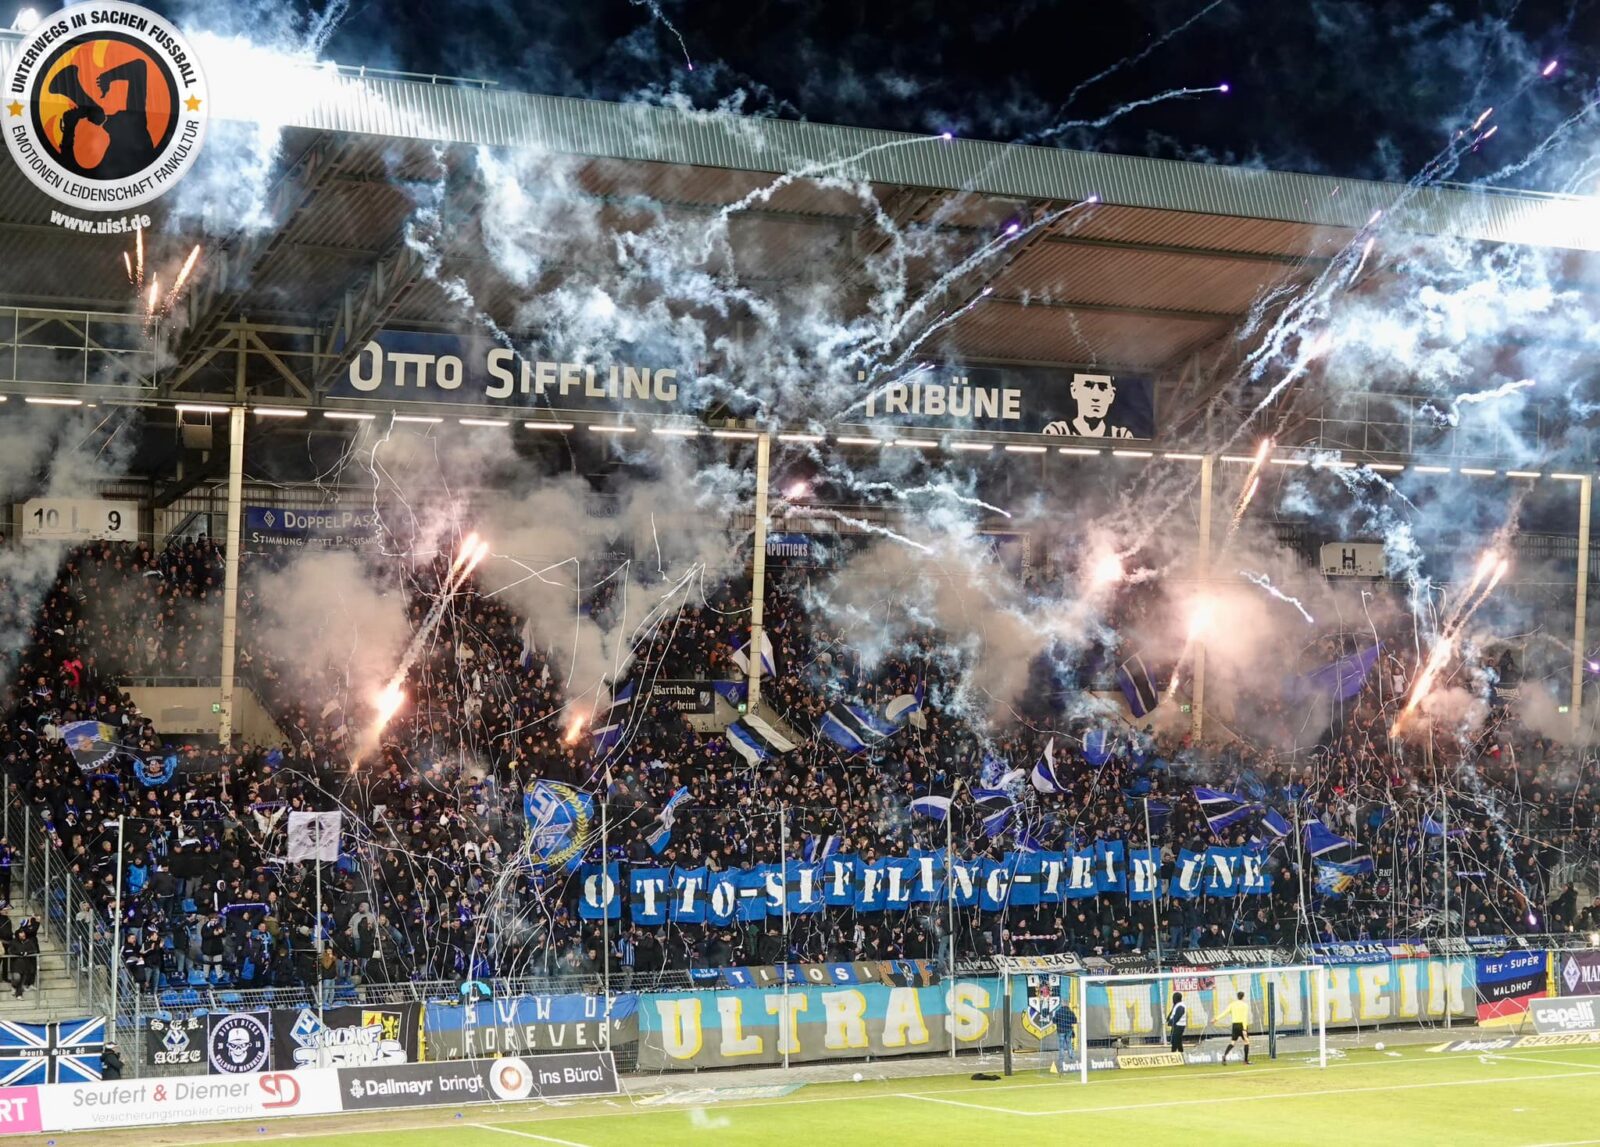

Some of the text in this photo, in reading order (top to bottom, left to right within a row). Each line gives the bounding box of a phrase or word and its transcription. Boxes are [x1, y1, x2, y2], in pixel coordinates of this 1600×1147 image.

[349, 340, 463, 392] OTTO
[485, 347, 677, 401] SIFFLING
[108, 510, 121, 531] 9
[1341, 548, 1356, 570] H
[732, 967, 872, 983] TIFOSI
[1485, 963, 1503, 975] HEY
[1510, 955, 1540, 970] SUPER
[1493, 979, 1533, 997] WALDHOF
[655, 982, 991, 1060] ULTRAS
[1536, 1002, 1595, 1028] capelli
[1091, 1059, 1115, 1069] bwin
[1120, 1053, 1183, 1068] SPORTWETTEN
[365, 1068, 604, 1097] Dallmayr bringt ins Büro!
[73, 1082, 250, 1108] Seufert & Diemer
[0, 1097, 28, 1122] RT
[91, 1103, 254, 1123] Versicherungsmakler GmbH
